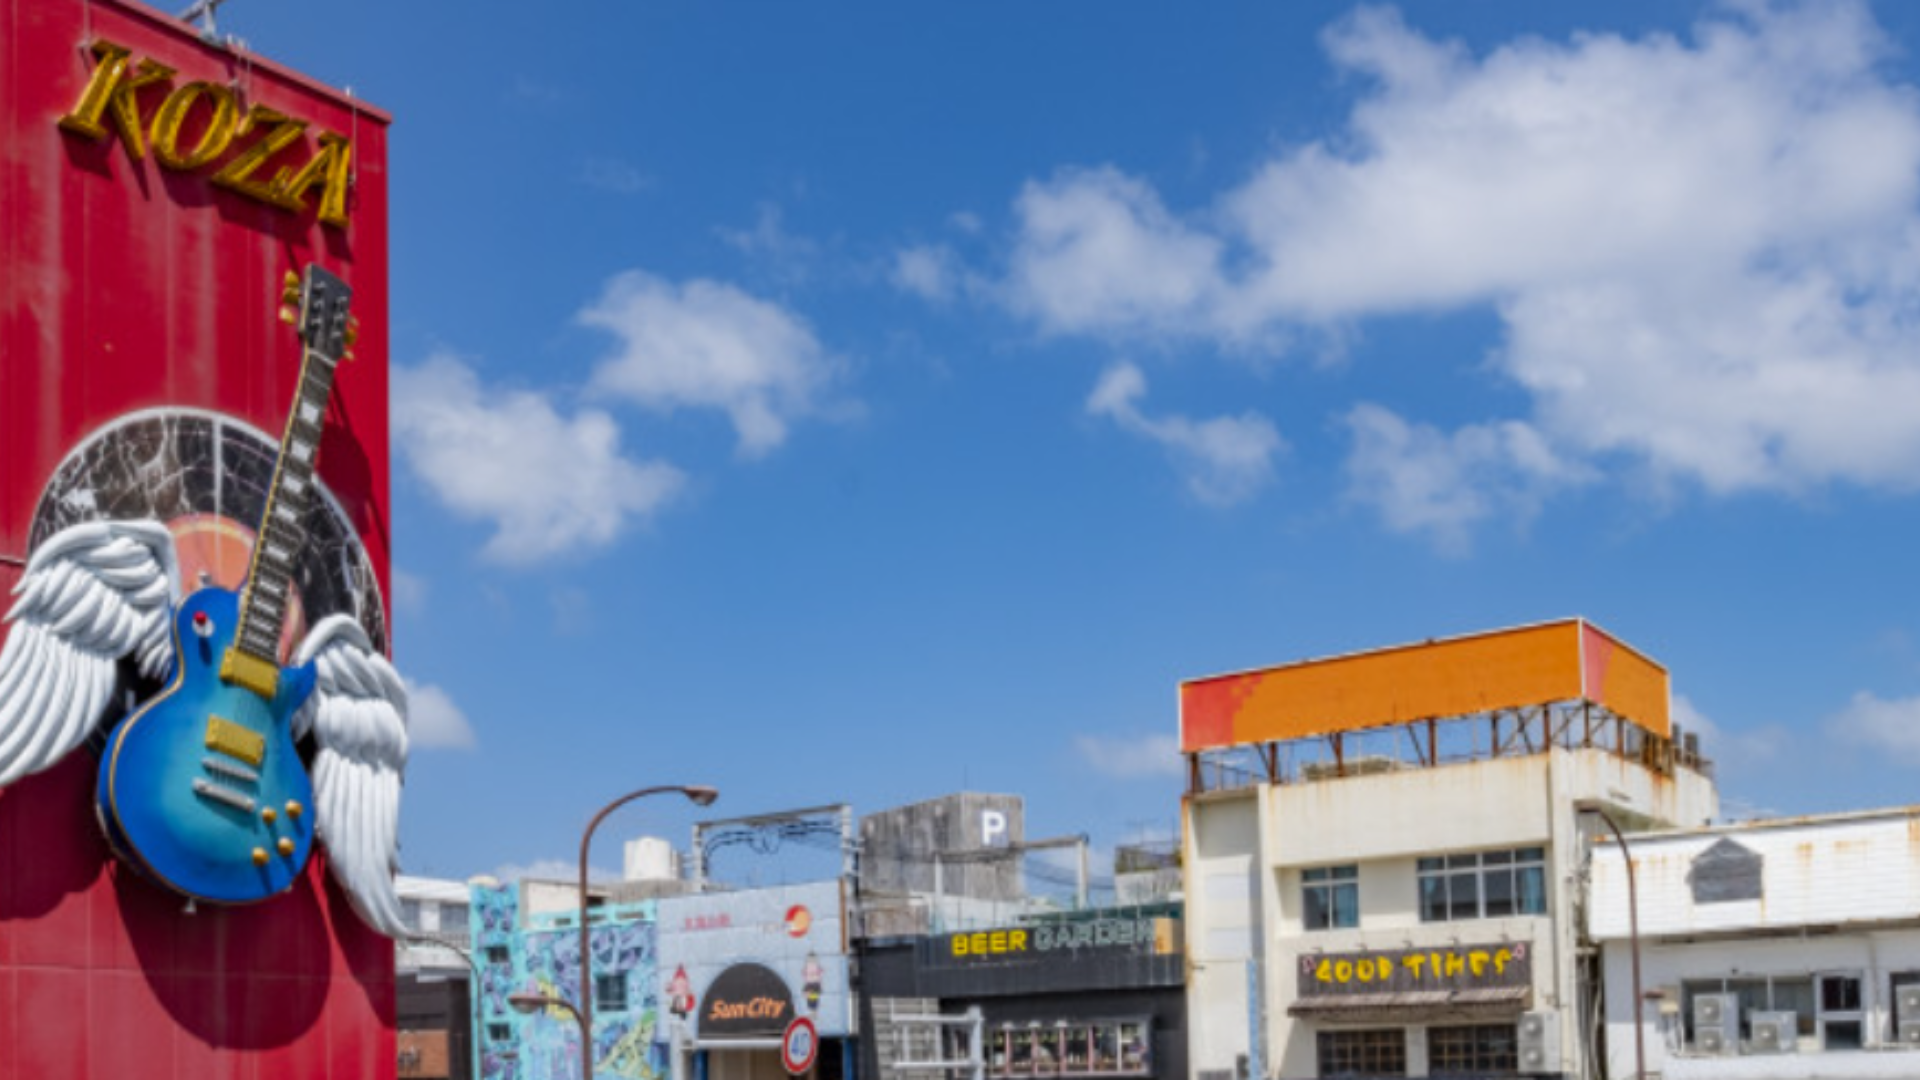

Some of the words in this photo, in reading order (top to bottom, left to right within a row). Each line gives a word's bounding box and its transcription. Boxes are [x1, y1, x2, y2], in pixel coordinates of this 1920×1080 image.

[58, 39, 352, 227] KOZA
[982, 810, 1006, 846] P
[951, 929, 1027, 956] BEER
[1034, 918, 1155, 952] GARDEN
[1315, 957, 1394, 983] GOOD
[1402, 948, 1513, 980] TIMES
[790, 1032, 809, 1057] 40
